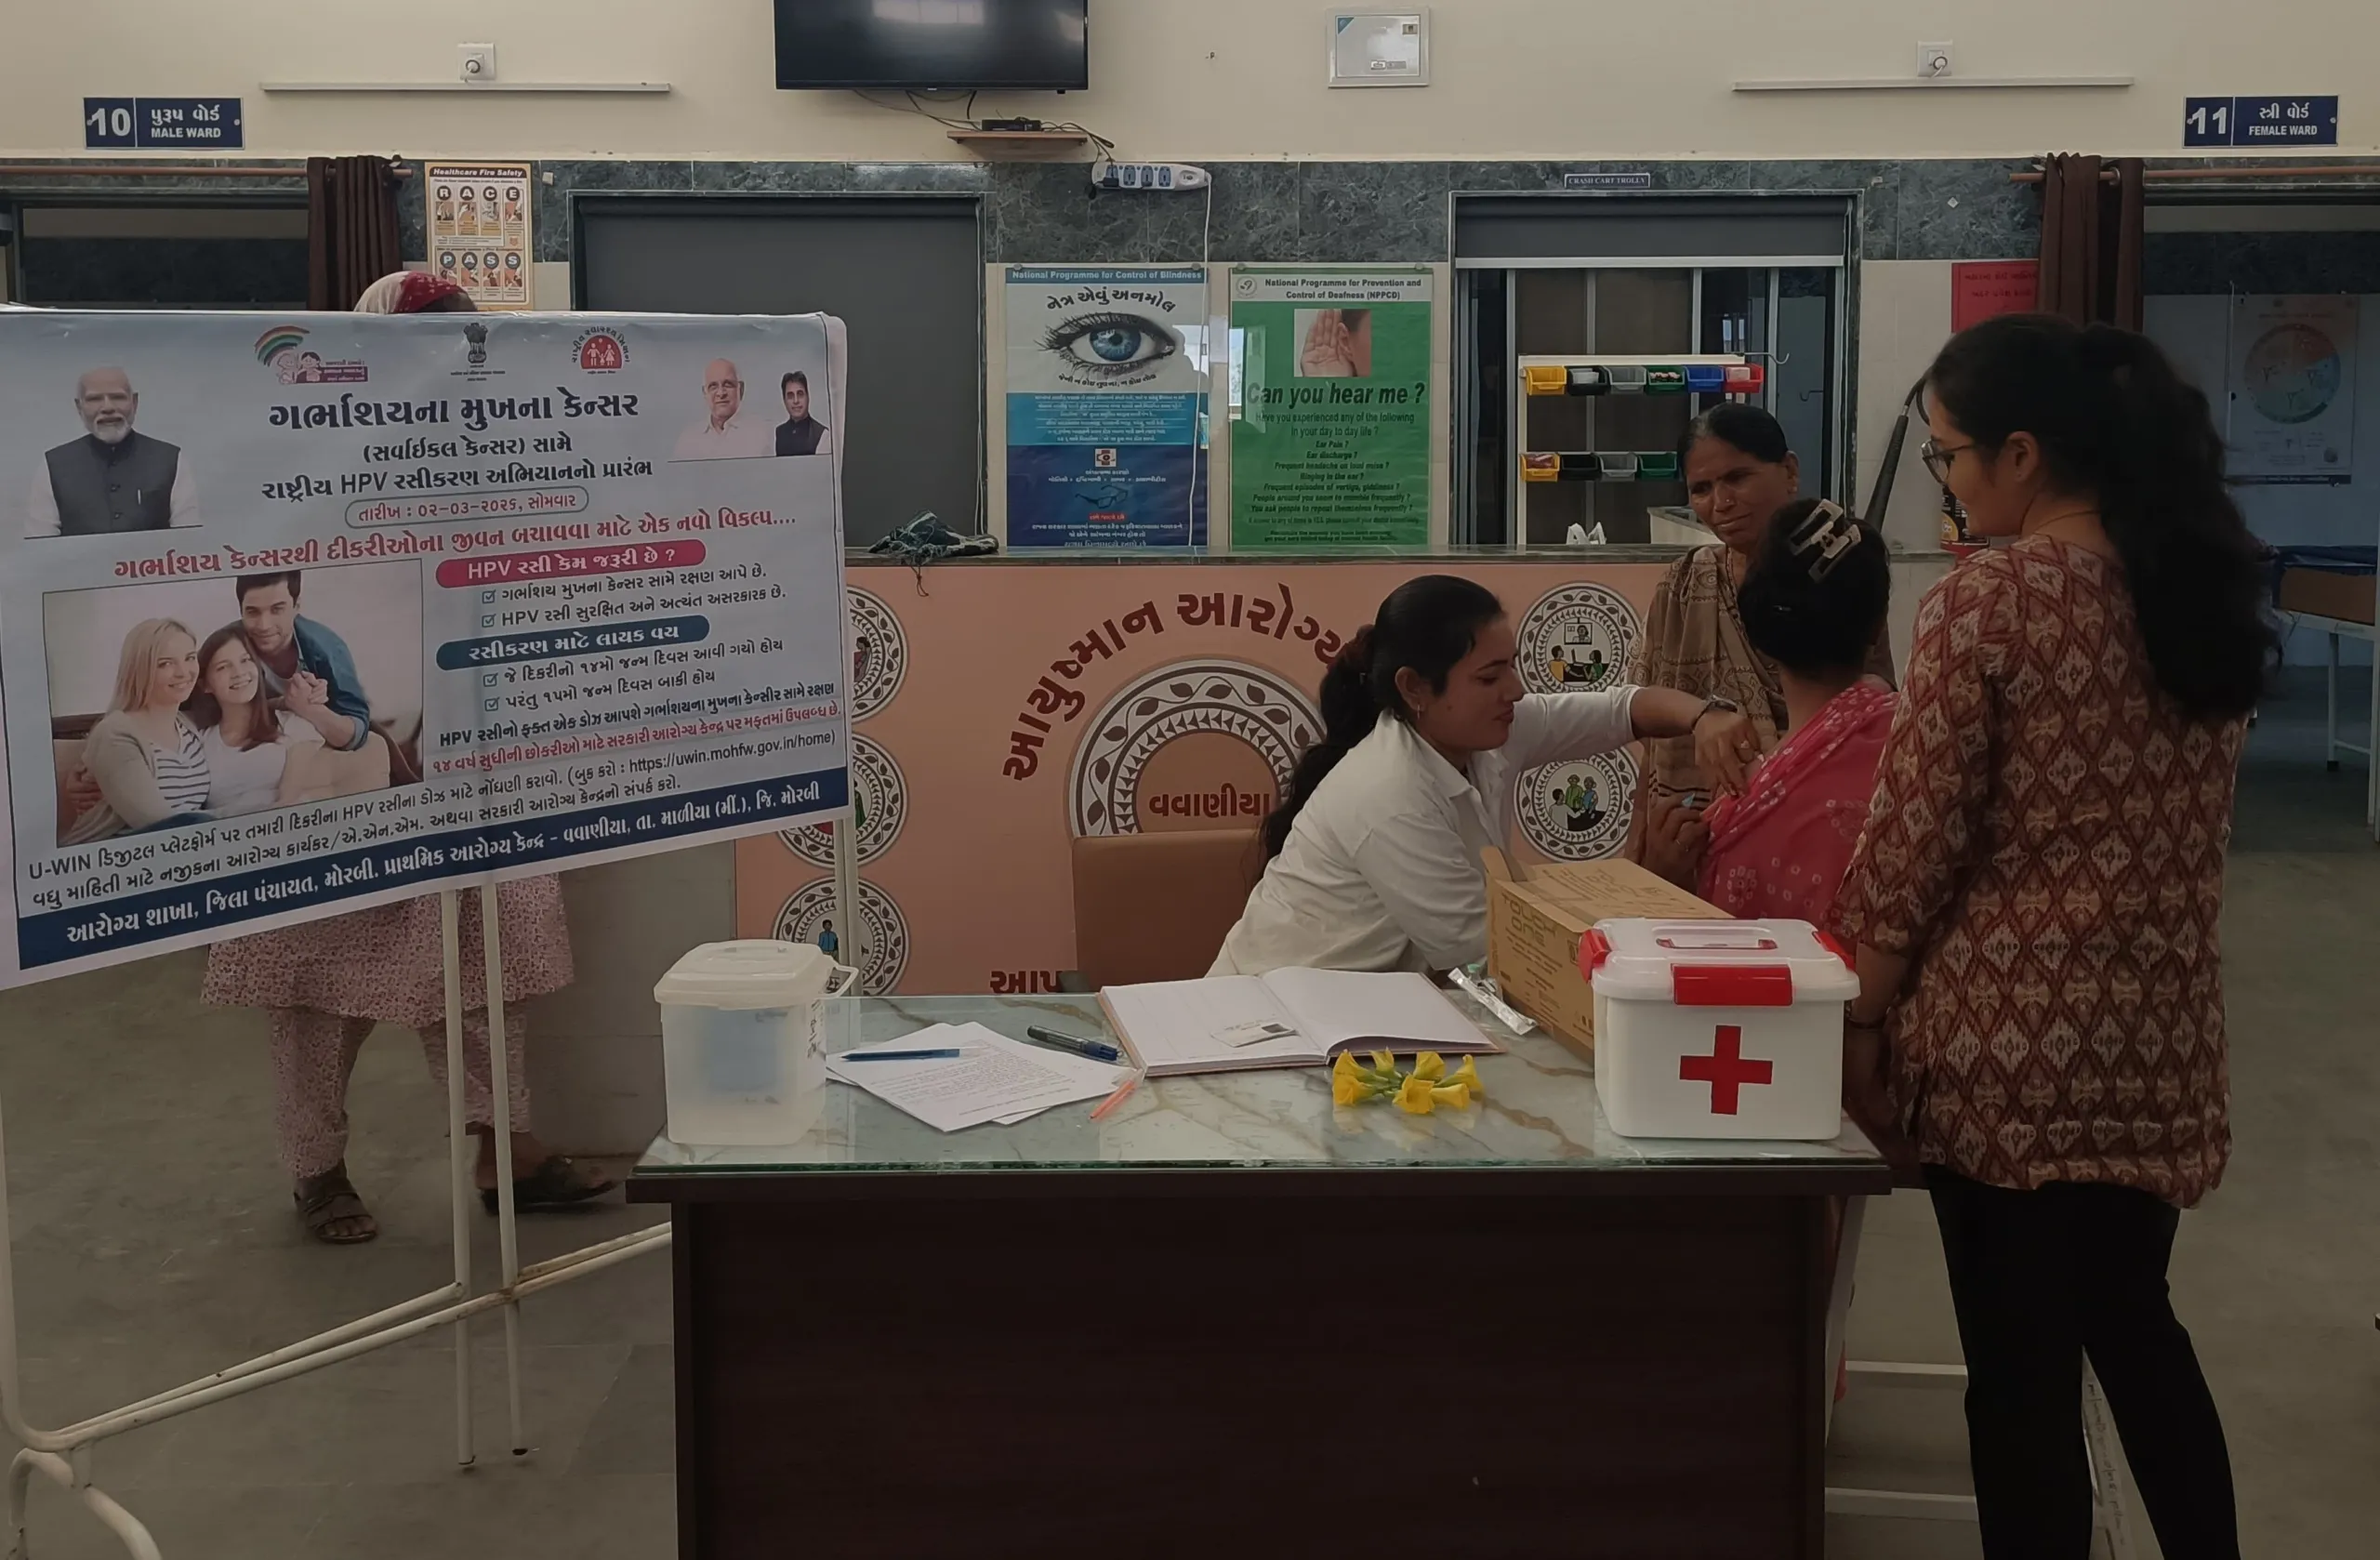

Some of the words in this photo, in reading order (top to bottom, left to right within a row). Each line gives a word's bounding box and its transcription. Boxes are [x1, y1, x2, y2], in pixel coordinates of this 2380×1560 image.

[92, 108, 131, 136] 10
[192, 104, 220, 121] વોર્ડ
[2192, 107, 2227, 134] 11
[2287, 102, 2309, 119] વોર્ડ
[152, 127, 184, 138] MALE
[186, 127, 221, 138] WARD
[2249, 126, 2287, 136] FEMALE
[2290, 126, 2318, 136] WARD
[1051, 271, 1099, 280] Programme
[1301, 279, 1346, 288] Programme
[1367, 291, 1400, 300] (NPPCD)
[269, 391, 450, 430] ગર્ભાશયના
[460, 396, 553, 431] મુખના
[555, 386, 639, 417] કેન્સર
[1247, 383, 1283, 403] Can
[1289, 388, 1323, 409] you
[1329, 383, 1373, 403] hear
[1379, 388, 1408, 403] me
[1414, 383, 1425, 403] ?
[1276, 414, 1290, 424] you
[1292, 413, 1339, 424] experienced
[1341, 414, 1354, 424] any
[1355, 413, 1364, 421] of
[1366, 413, 1377, 421] the
[1380, 413, 1414, 424] following
[458, 434, 525, 456] કેન્સર)
[532, 430, 573, 453] સામે
[340, 470, 388, 495] HPV
[392, 466, 480, 490] રસીકરણ
[484, 457, 596, 483] અભિયાનનો
[602, 455, 653, 478] પ્રારંભ
[358, 501, 401, 522] તારીખ
[527, 491, 576, 509] સોમવાર
[113, 548, 222, 578] ગર્ભાશય
[222, 537, 319, 569] કેન્સરથી
[325, 529, 444, 561] દીકરીઓના
[450, 529, 505, 553] જીવન
[510, 522, 590, 544] બચાવવા
[596, 513, 631, 537] માટે
[637, 510, 670, 534] એક
[676, 508, 711, 531] નવો
[468, 559, 511, 579] HPV
[516, 554, 551, 575] રસી
[553, 552, 587, 571] કેમ
[592, 547, 638, 568] જરૂરી
[642, 545, 658, 563] છે
[665, 548, 675, 562] ?
[501, 581, 556, 601] ગર્ભાશય
[561, 580, 602, 600] મુખના
[605, 575, 644, 591] કેન્સર
[647, 569, 674, 588] સામે
[679, 570, 714, 585] રક્ષણ
[718, 562, 747, 580] આપે
[750, 562, 766, 577] છે.
[501, 608, 539, 627] HPV
[544, 602, 570, 621] રસી
[628, 595, 654, 613] અને
[659, 591, 702, 609] અત્યંત
[706, 588, 766, 604] અસરકારક
[770, 583, 786, 599] છે.
[468, 639, 549, 660] રસીકરણ
[553, 630, 589, 650] માટે
[595, 628, 644, 646] લાયક
[650, 625, 680, 640] વય
[1003, 601, 1164, 781] આયુષ્માન
[29, 853, 91, 879] U-WIN
[342, 800, 375, 821] HPV
